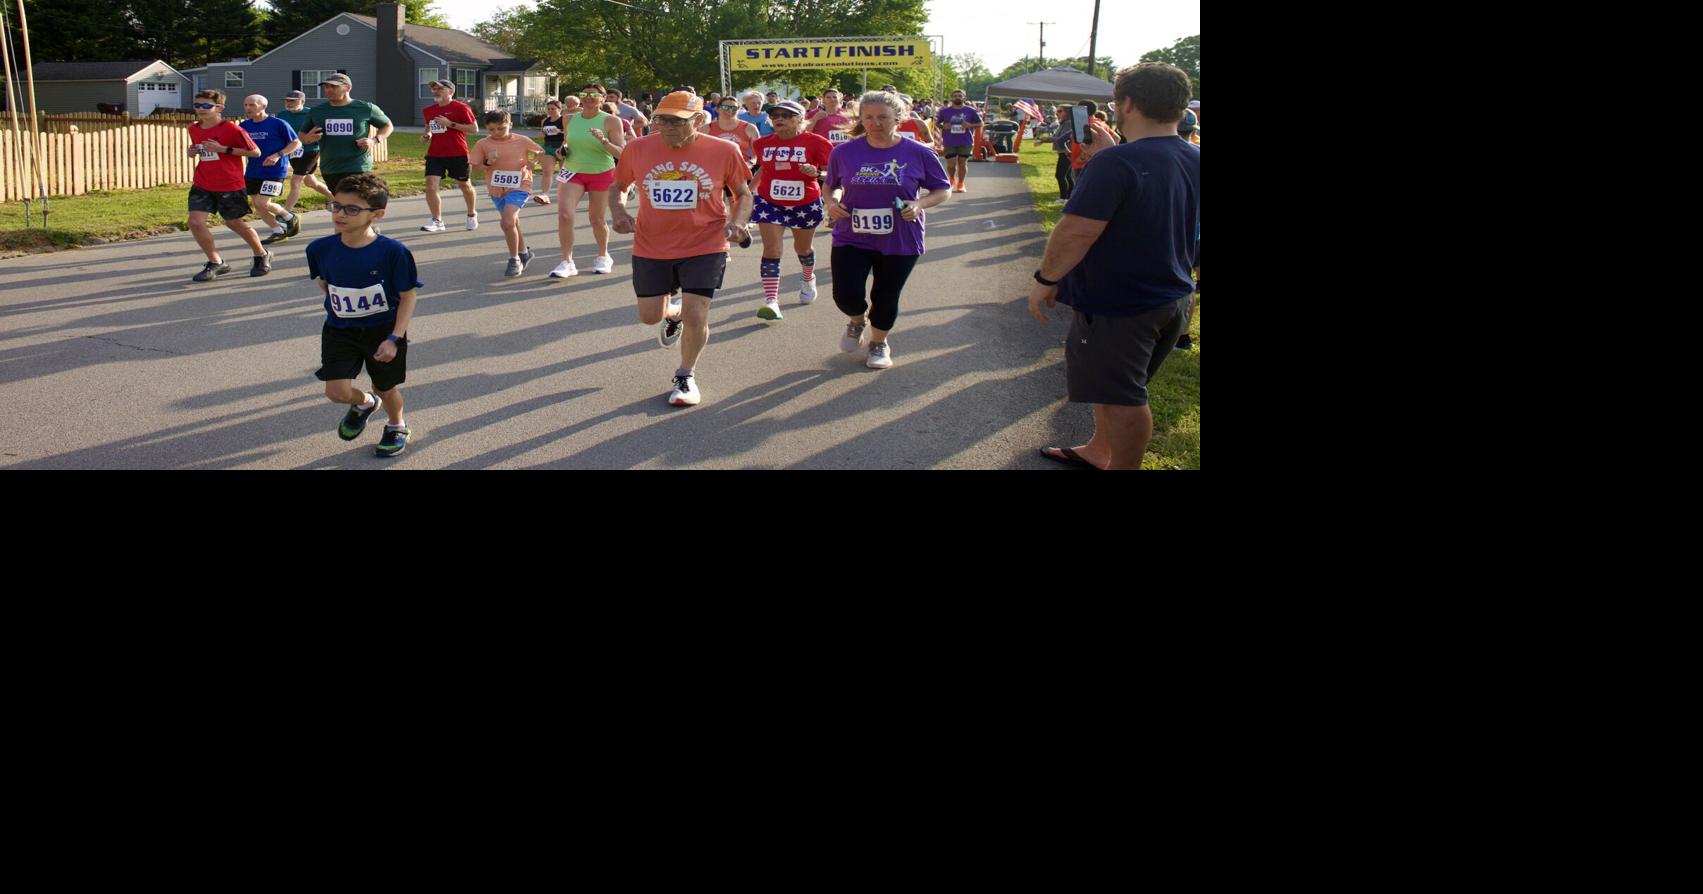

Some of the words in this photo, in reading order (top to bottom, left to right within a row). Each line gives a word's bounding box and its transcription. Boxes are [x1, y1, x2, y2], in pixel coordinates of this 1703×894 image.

[746, 45, 914, 59] START/FINISH
[327, 122, 353, 133] 9090
[493, 174, 519, 184] 5503
[679, 161, 714, 190] SPRINT
[653, 188, 694, 203] 5622
[773, 185, 801, 196] 5621
[853, 214, 892, 229] 9199
[331, 293, 385, 312] 9144
